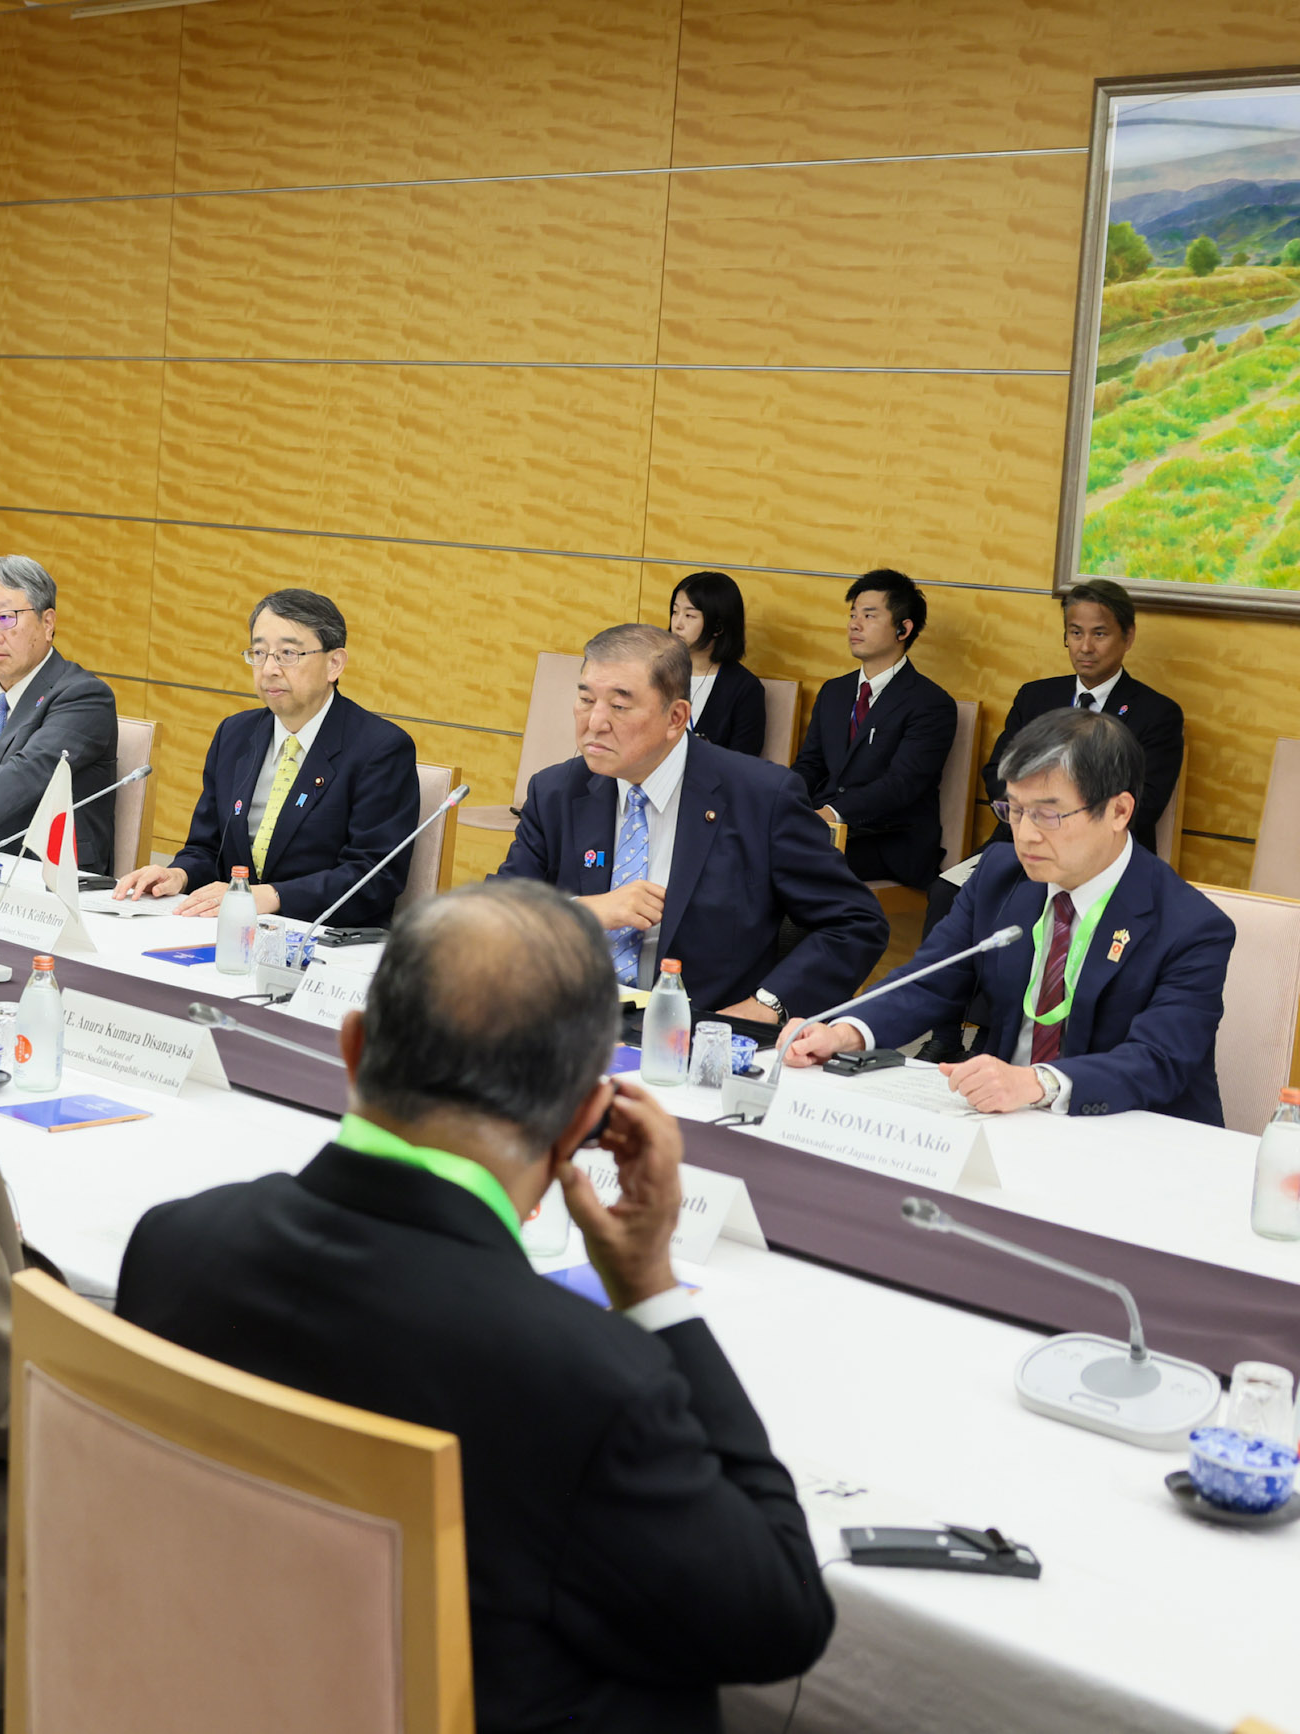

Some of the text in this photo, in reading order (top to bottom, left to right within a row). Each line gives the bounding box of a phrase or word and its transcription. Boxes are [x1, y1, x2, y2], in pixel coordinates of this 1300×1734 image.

[28, 909, 64, 928] Keiichiro
[301, 978, 324, 995] H.E.
[328, 985, 345, 1001] Mr.
[317, 1008, 338, 1019] Prime
[76, 1015, 106, 1035] Anura
[104, 1022, 141, 1045] Kumara
[142, 1032, 194, 1060] Disanayaka
[96, 1044, 134, 1062] President of
[111, 1061, 140, 1079] Republic
[139, 1069, 149, 1079] of
[148, 1071, 158, 1082] Sri
[158, 1073, 180, 1089] Lanka
[788, 1100, 951, 1154] Mr. ISOMATA Akio
[779, 1130, 834, 1152] Ambassador
[847, 1147, 876, 1162] Japan
[906, 1161, 938, 1178] Lanka
